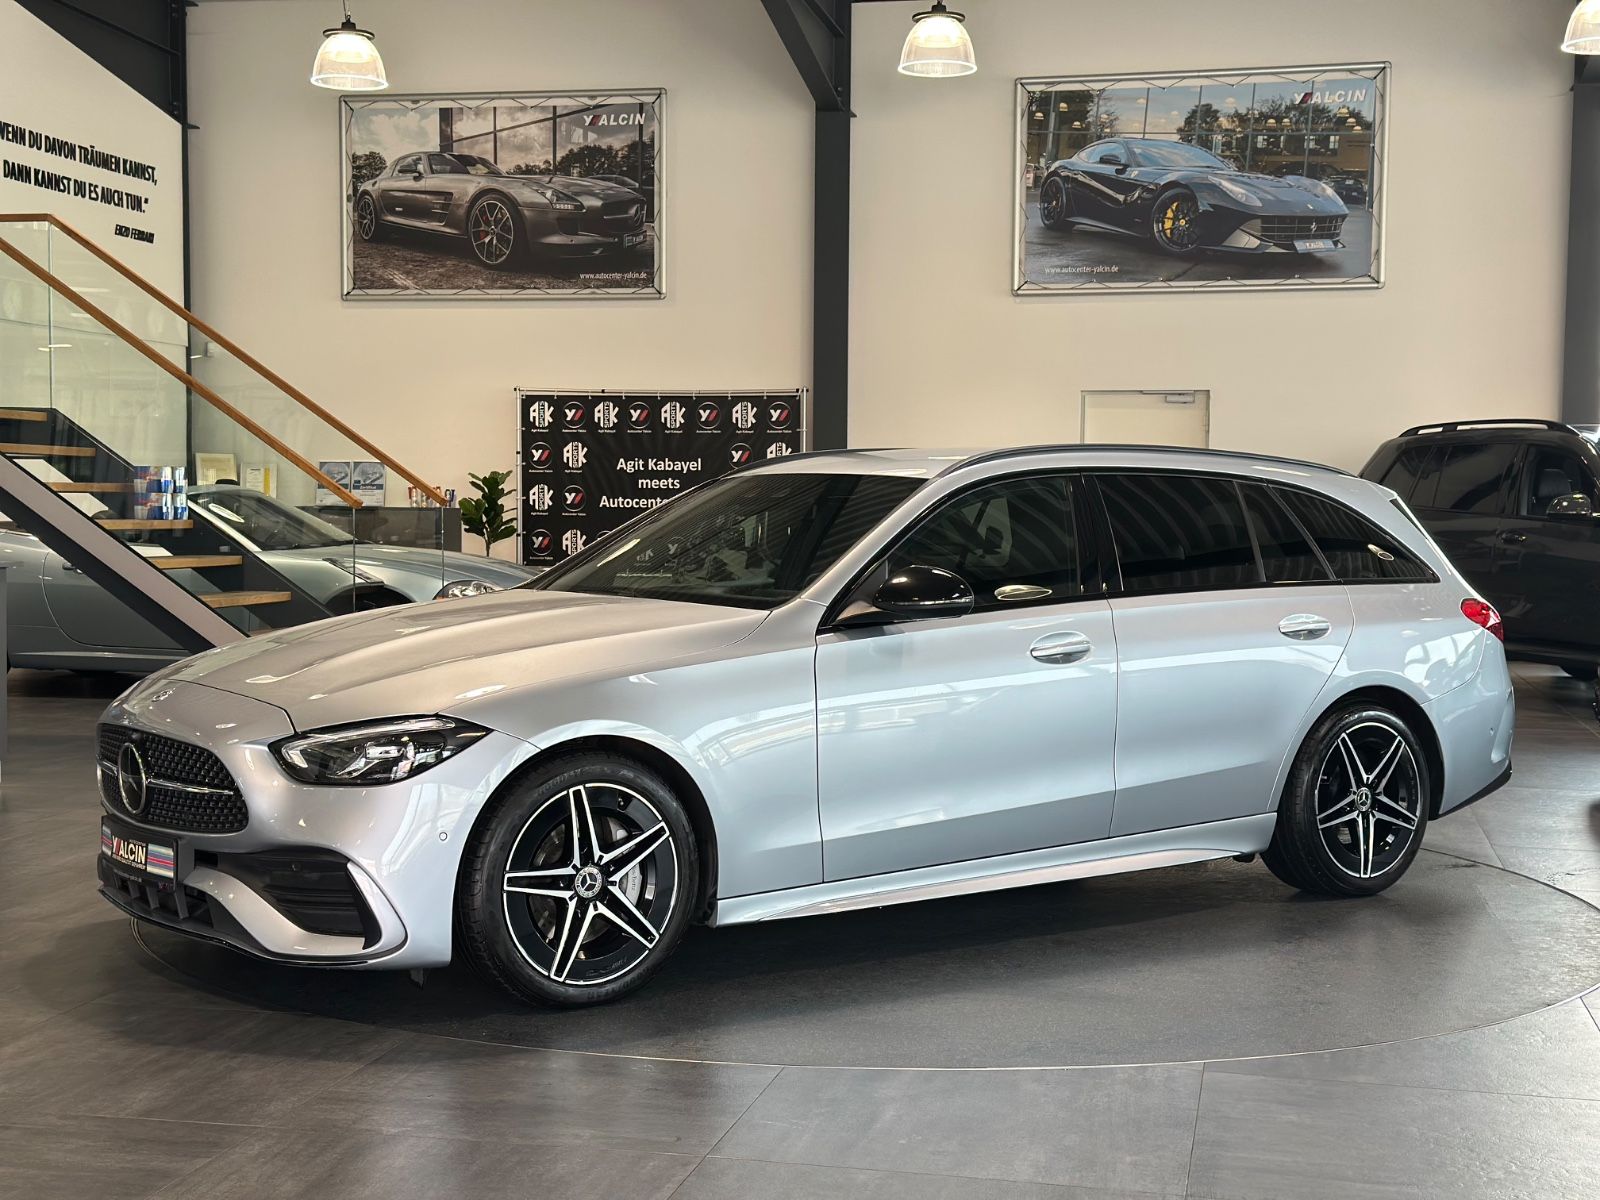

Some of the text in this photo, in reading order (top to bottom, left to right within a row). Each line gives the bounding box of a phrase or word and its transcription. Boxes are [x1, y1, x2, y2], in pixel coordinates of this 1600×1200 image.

[1294, 89, 1366, 105] YALCIN
[583, 113, 646, 126] YALCIN
[28, 129, 43, 151] DU
[44, 134, 77, 161] DAVON
[77, 144, 121, 173] TRÄUMEN
[122, 158, 158, 186] KANNST,
[3, 159, 31, 184] DANN
[34, 168, 72, 195] KANNST
[73, 179, 86, 199] DU
[88, 182, 100, 202] ES
[100, 186, 124, 208] AUCH
[617, 457, 702, 474] Agit Kabayel
[638, 478, 680, 489] meets
[112, 835, 146, 865] YALCIN
